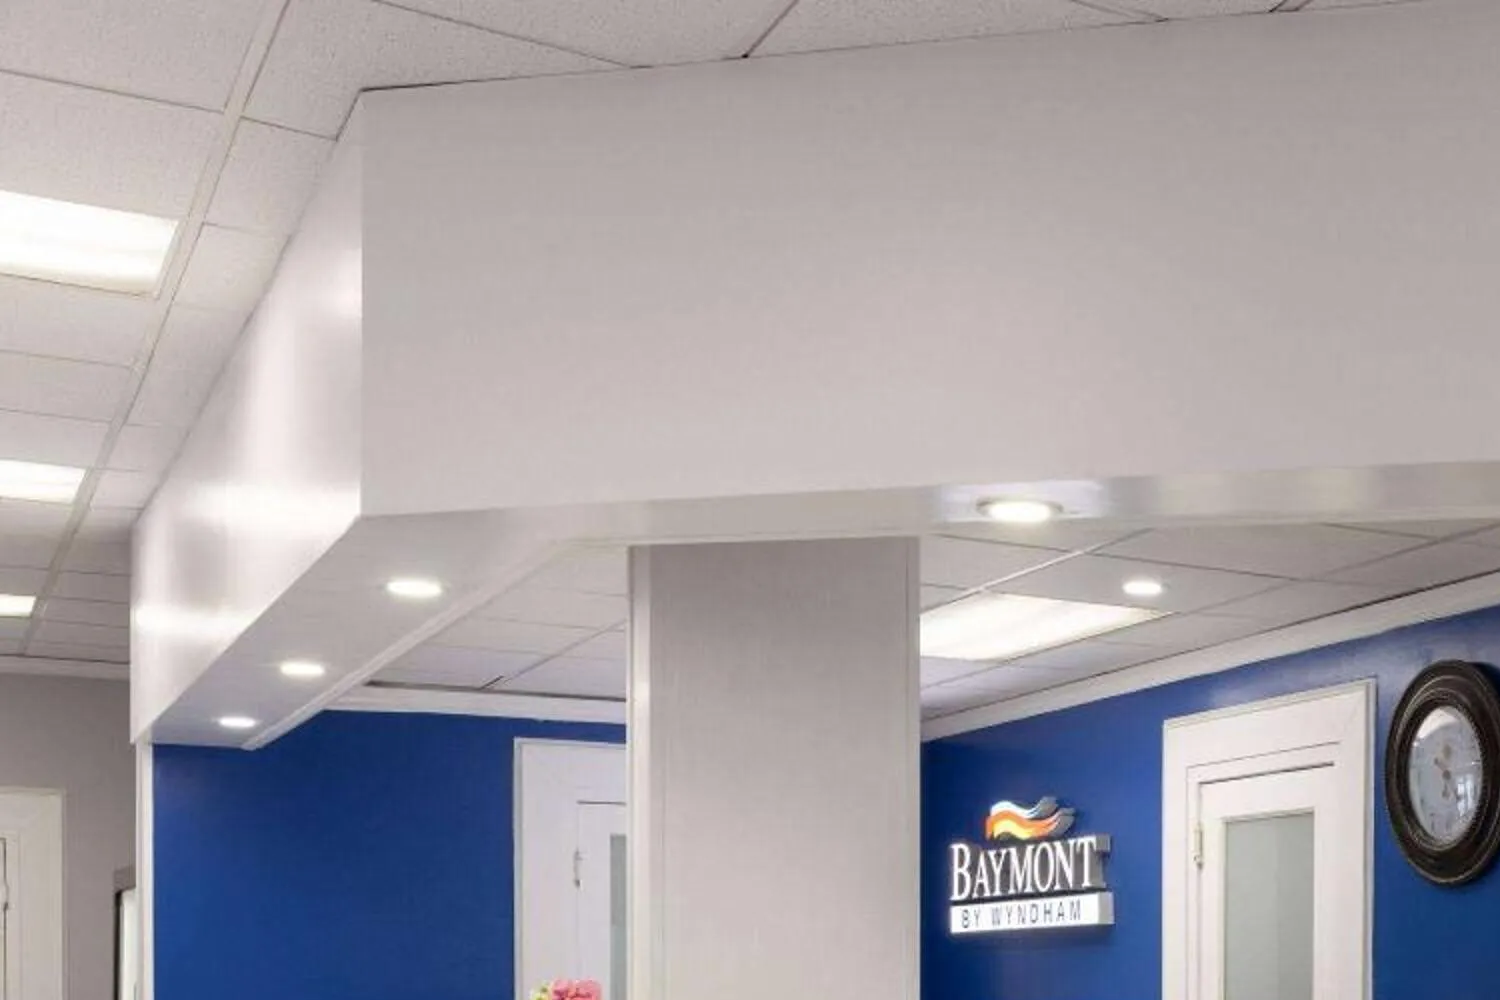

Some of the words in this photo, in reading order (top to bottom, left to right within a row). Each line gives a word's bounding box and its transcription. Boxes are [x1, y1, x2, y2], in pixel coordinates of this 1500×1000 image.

[950, 835, 1099, 901] BAYMONT
[961, 908, 981, 929] BY
[991, 900, 1082, 926] WYNDHAM
